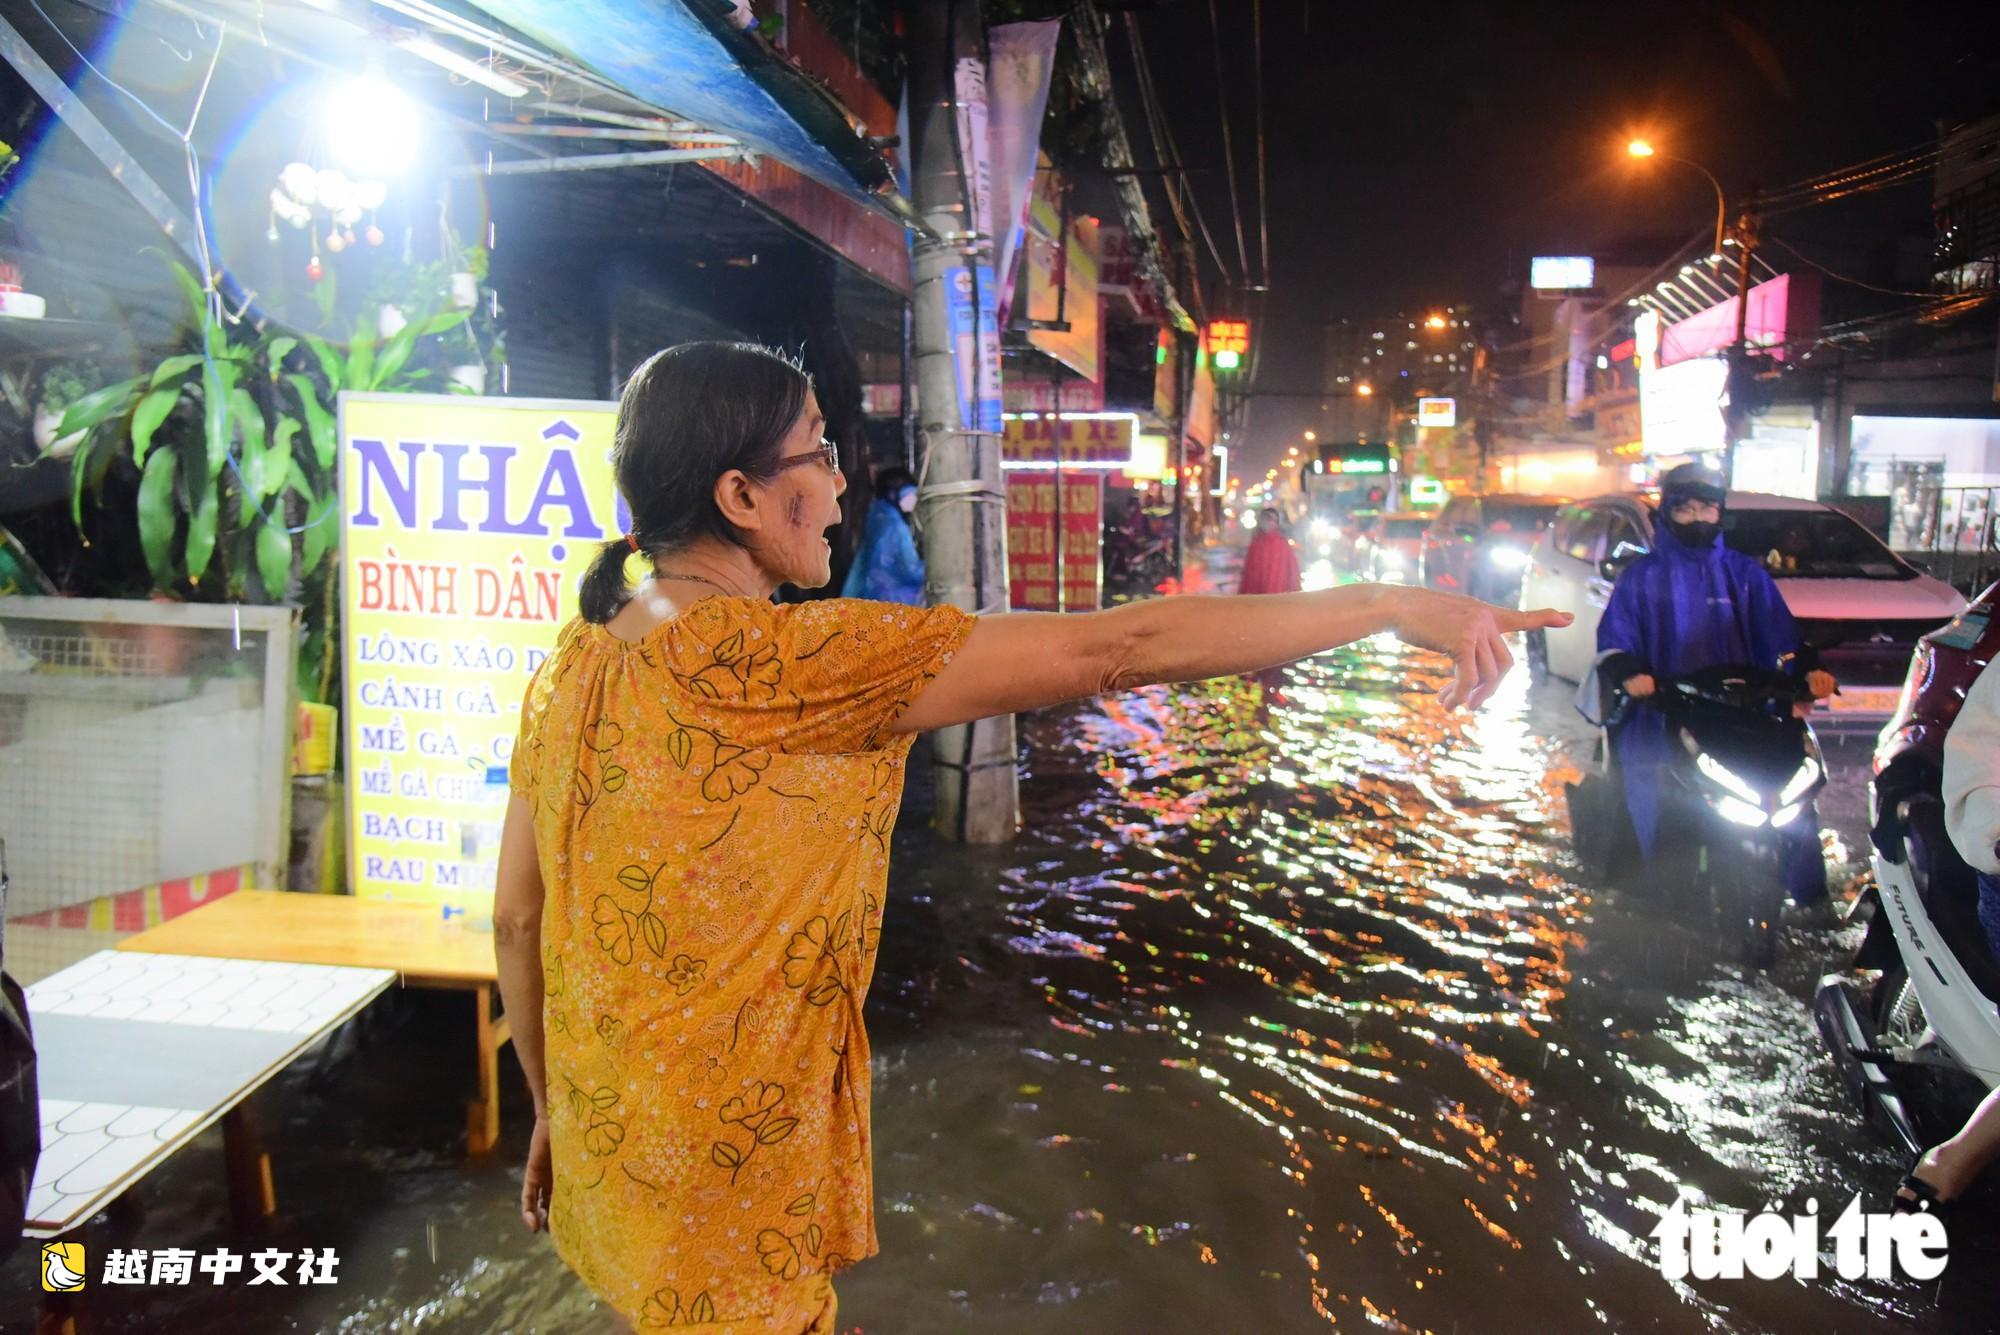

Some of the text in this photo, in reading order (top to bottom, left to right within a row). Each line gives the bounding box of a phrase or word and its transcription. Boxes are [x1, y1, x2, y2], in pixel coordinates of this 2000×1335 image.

[352, 420, 632, 561] NHẬ
[359, 547, 561, 622] BÌNH DÂN
[360, 633, 438, 665] LÒNG
[452, 640, 513, 670] XÀO
[361, 678, 441, 710] CÁNH
[457, 685, 496, 714] GÀ
[419, 729, 458, 756] GÀ
[364, 813, 444, 843] BẠCH
[366, 856, 423, 883] RAU
[1889, 884, 1925, 951] FUTURE
